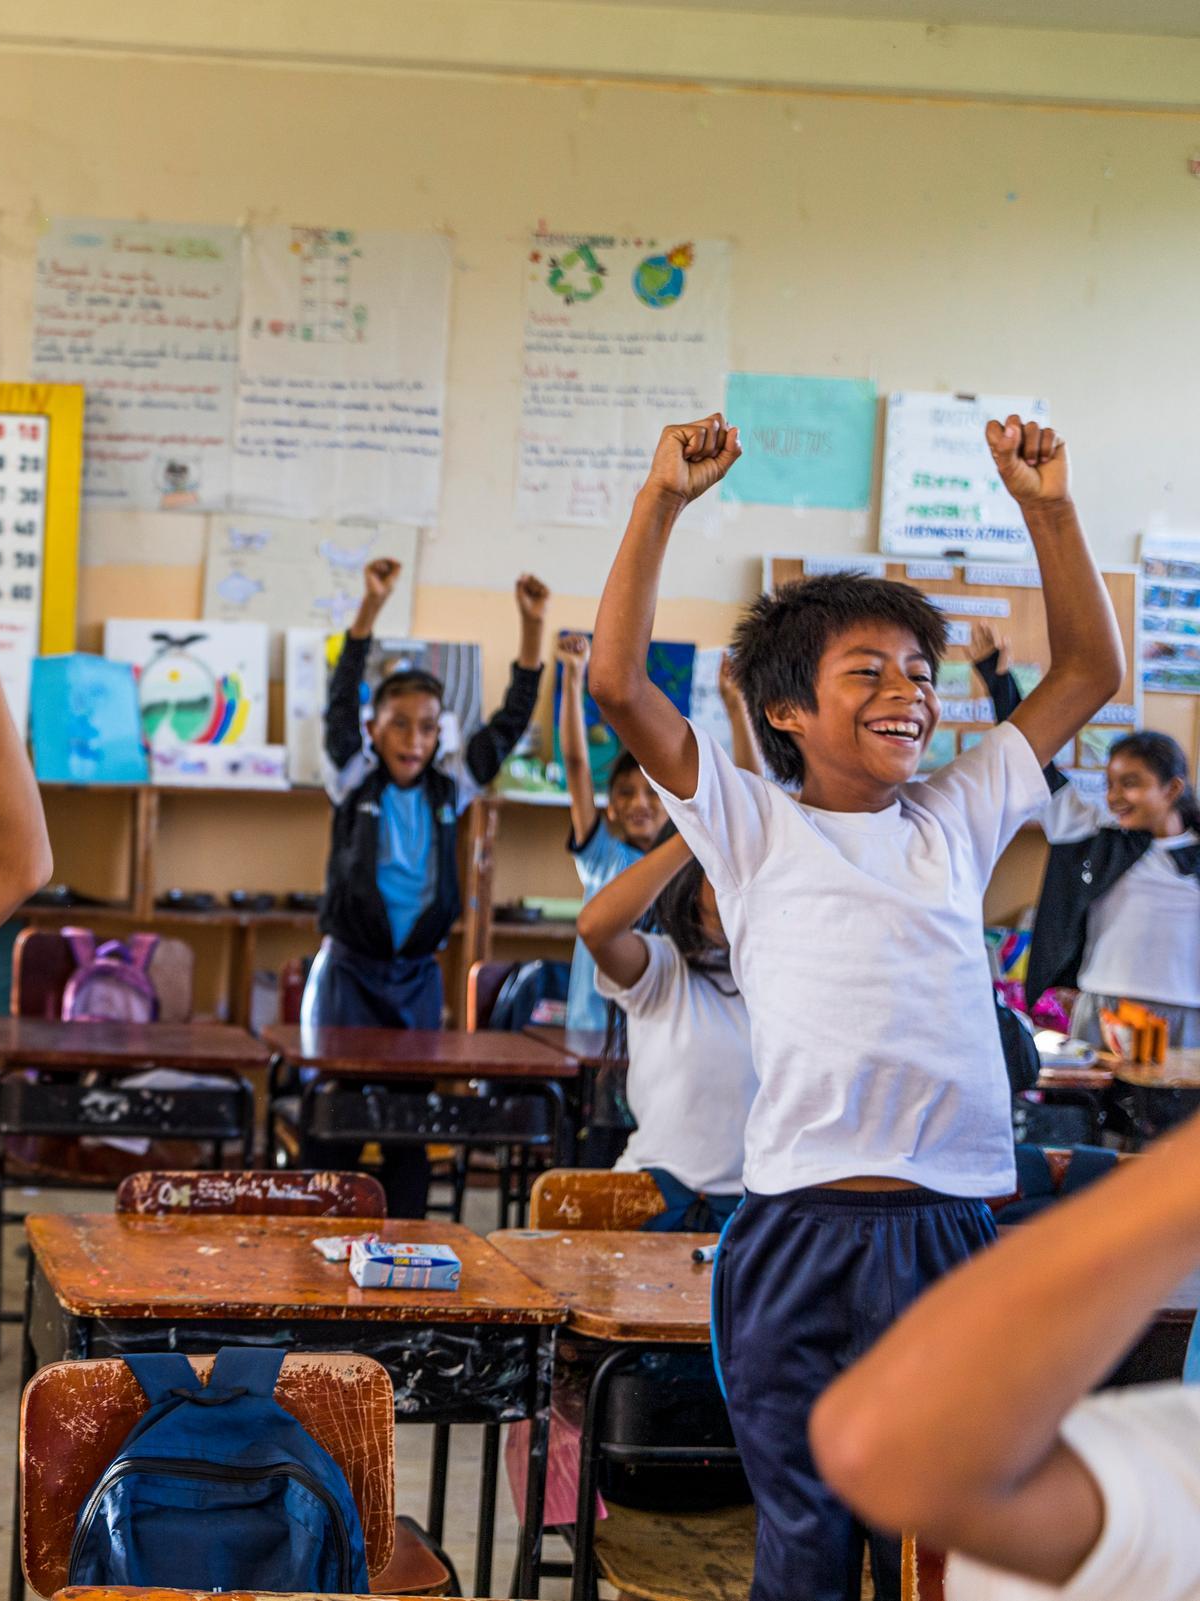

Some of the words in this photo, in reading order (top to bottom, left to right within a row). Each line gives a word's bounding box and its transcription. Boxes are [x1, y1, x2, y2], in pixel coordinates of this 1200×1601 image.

[18, 423, 41, 442] 10
[18, 454, 43, 474] 20
[18, 486, 41, 506] 30
[12, 519, 37, 538] 40
[13, 551, 38, 569] 50
[10, 584, 34, 601] 60
